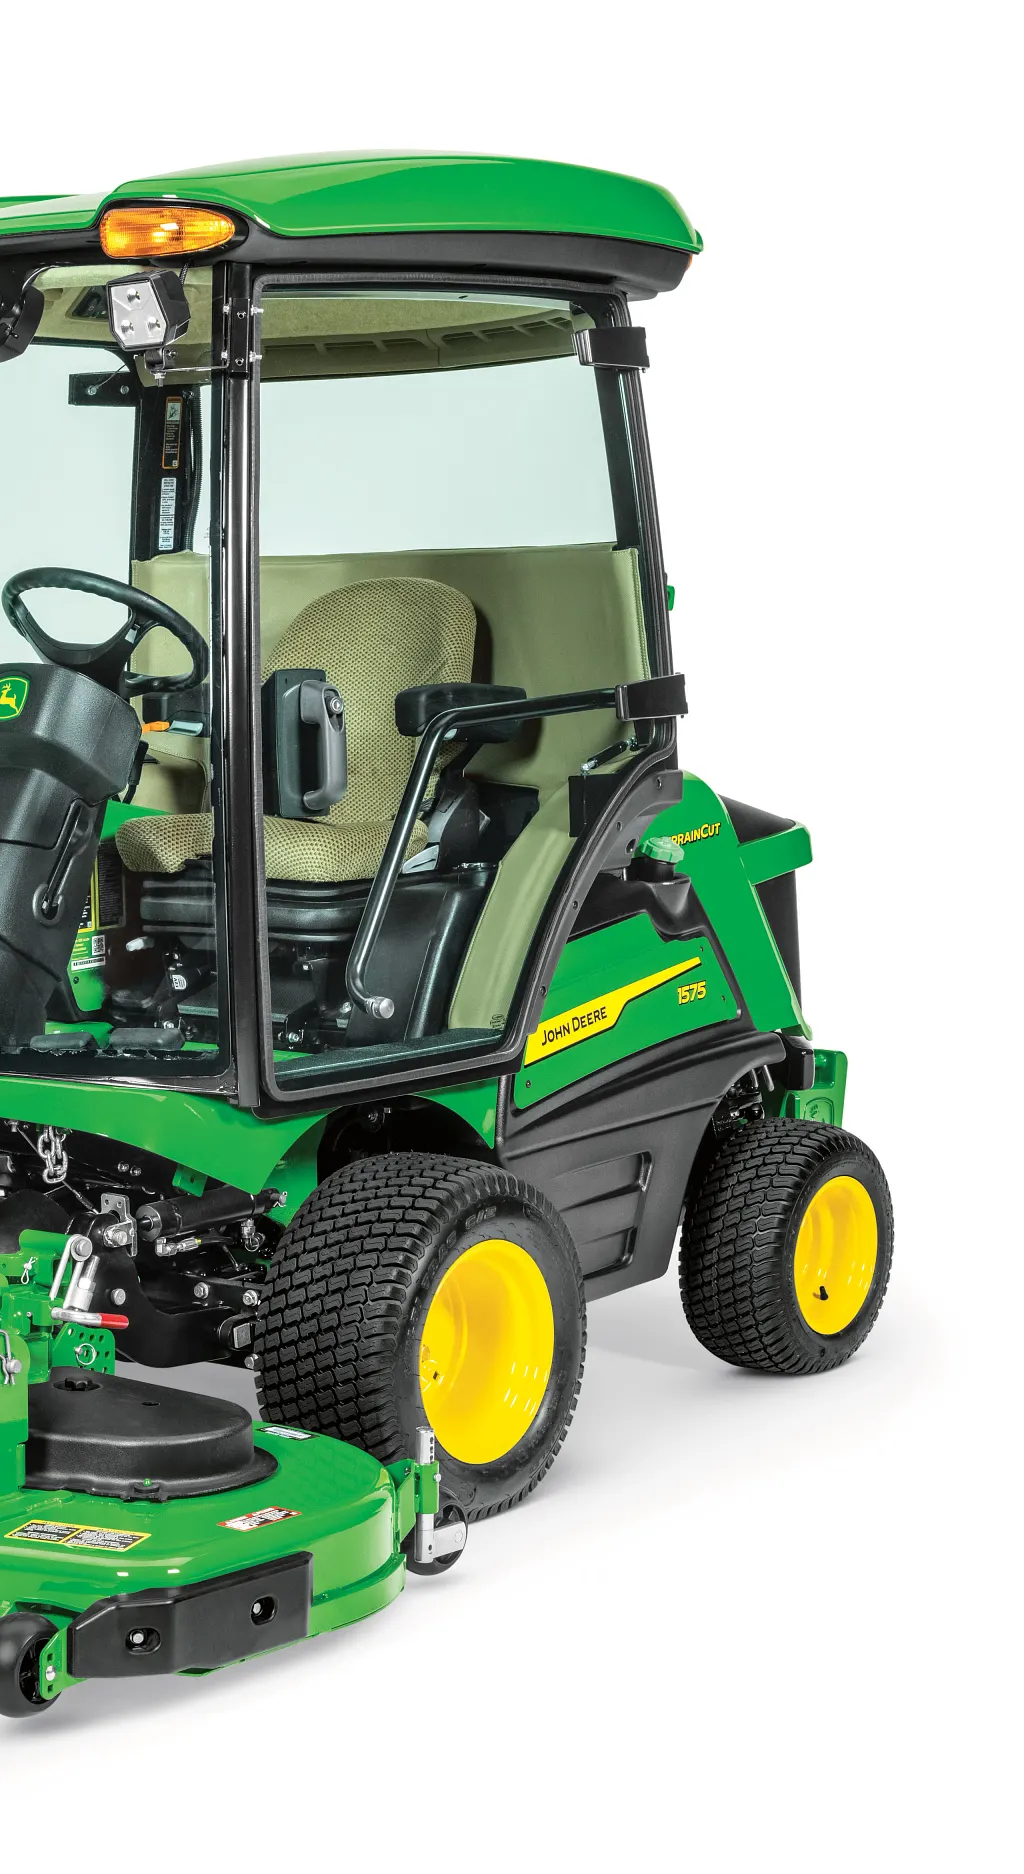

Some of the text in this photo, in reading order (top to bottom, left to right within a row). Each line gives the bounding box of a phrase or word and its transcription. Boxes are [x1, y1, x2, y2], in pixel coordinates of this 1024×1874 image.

[677, 979, 707, 1005] 1575
[542, 1006, 608, 1046] JOHN DEERE
